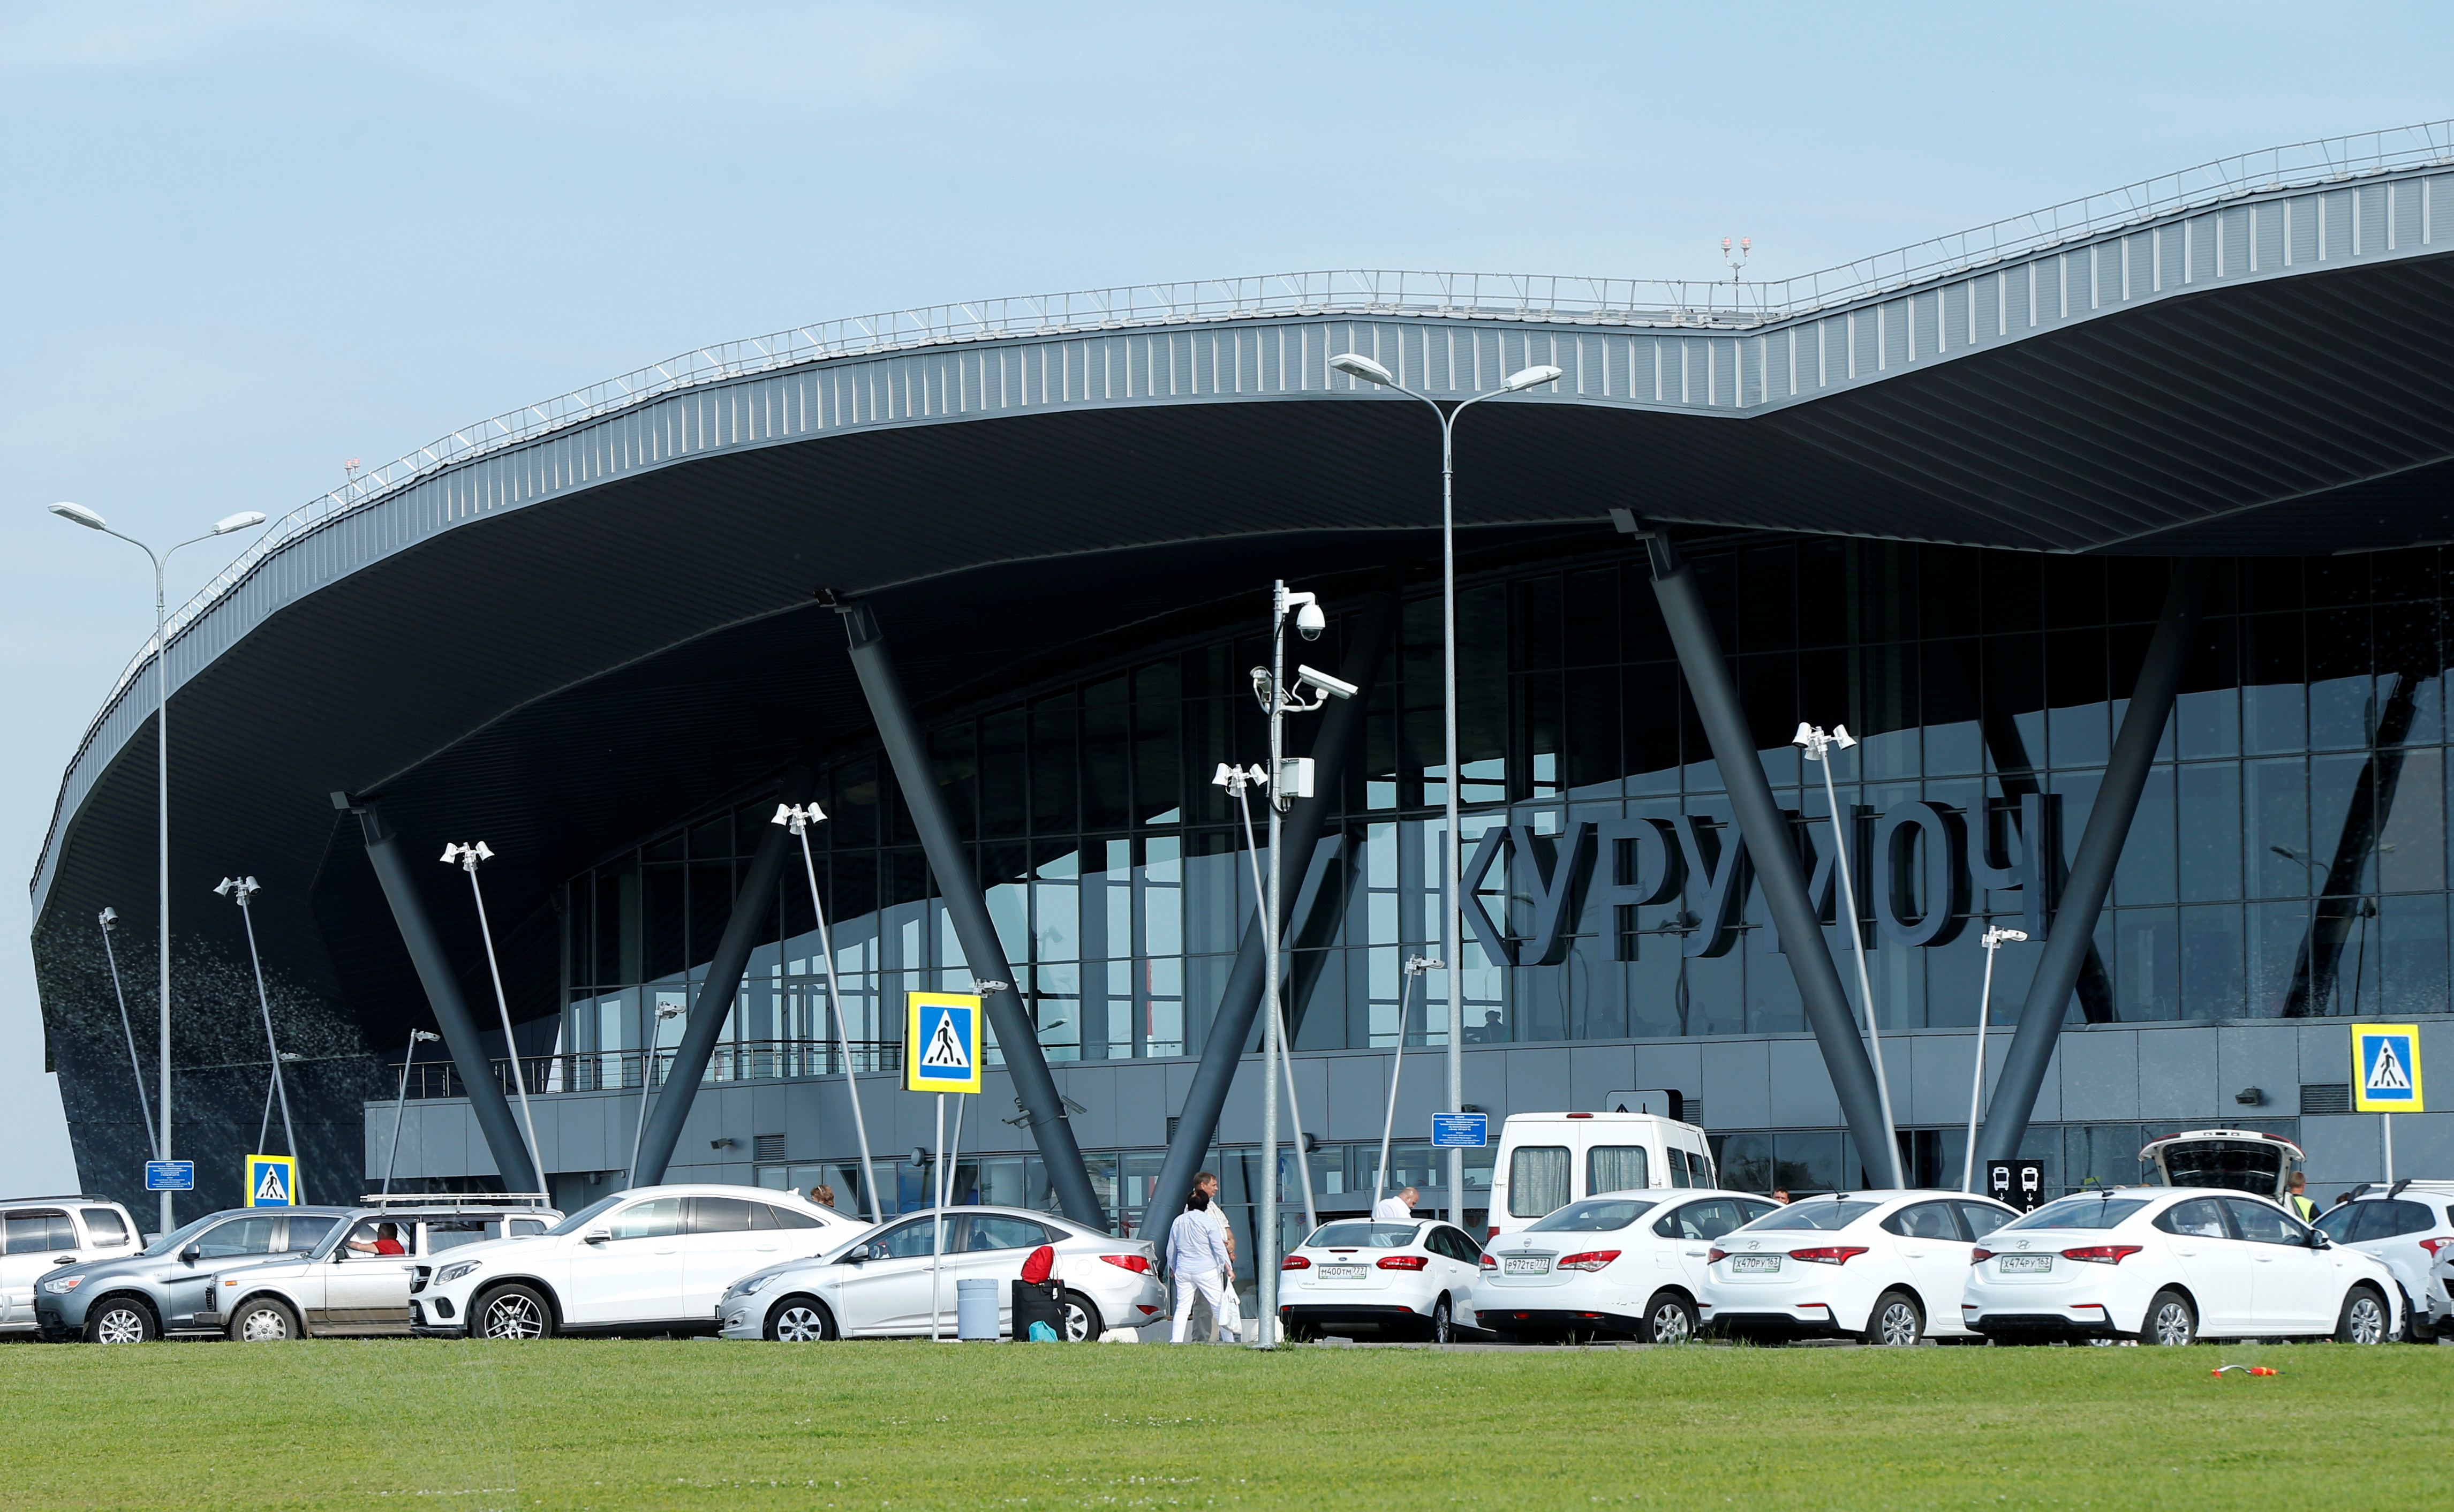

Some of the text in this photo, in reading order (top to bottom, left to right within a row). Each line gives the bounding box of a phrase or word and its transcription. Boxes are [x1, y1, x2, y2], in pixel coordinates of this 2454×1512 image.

[1508, 1260, 1534, 1269] Р972ТЕ
[1767, 1257, 1778, 1265] 163
[2037, 1257, 2049, 1265] 163
[1321, 1267, 1351, 1275] М400ТМ
